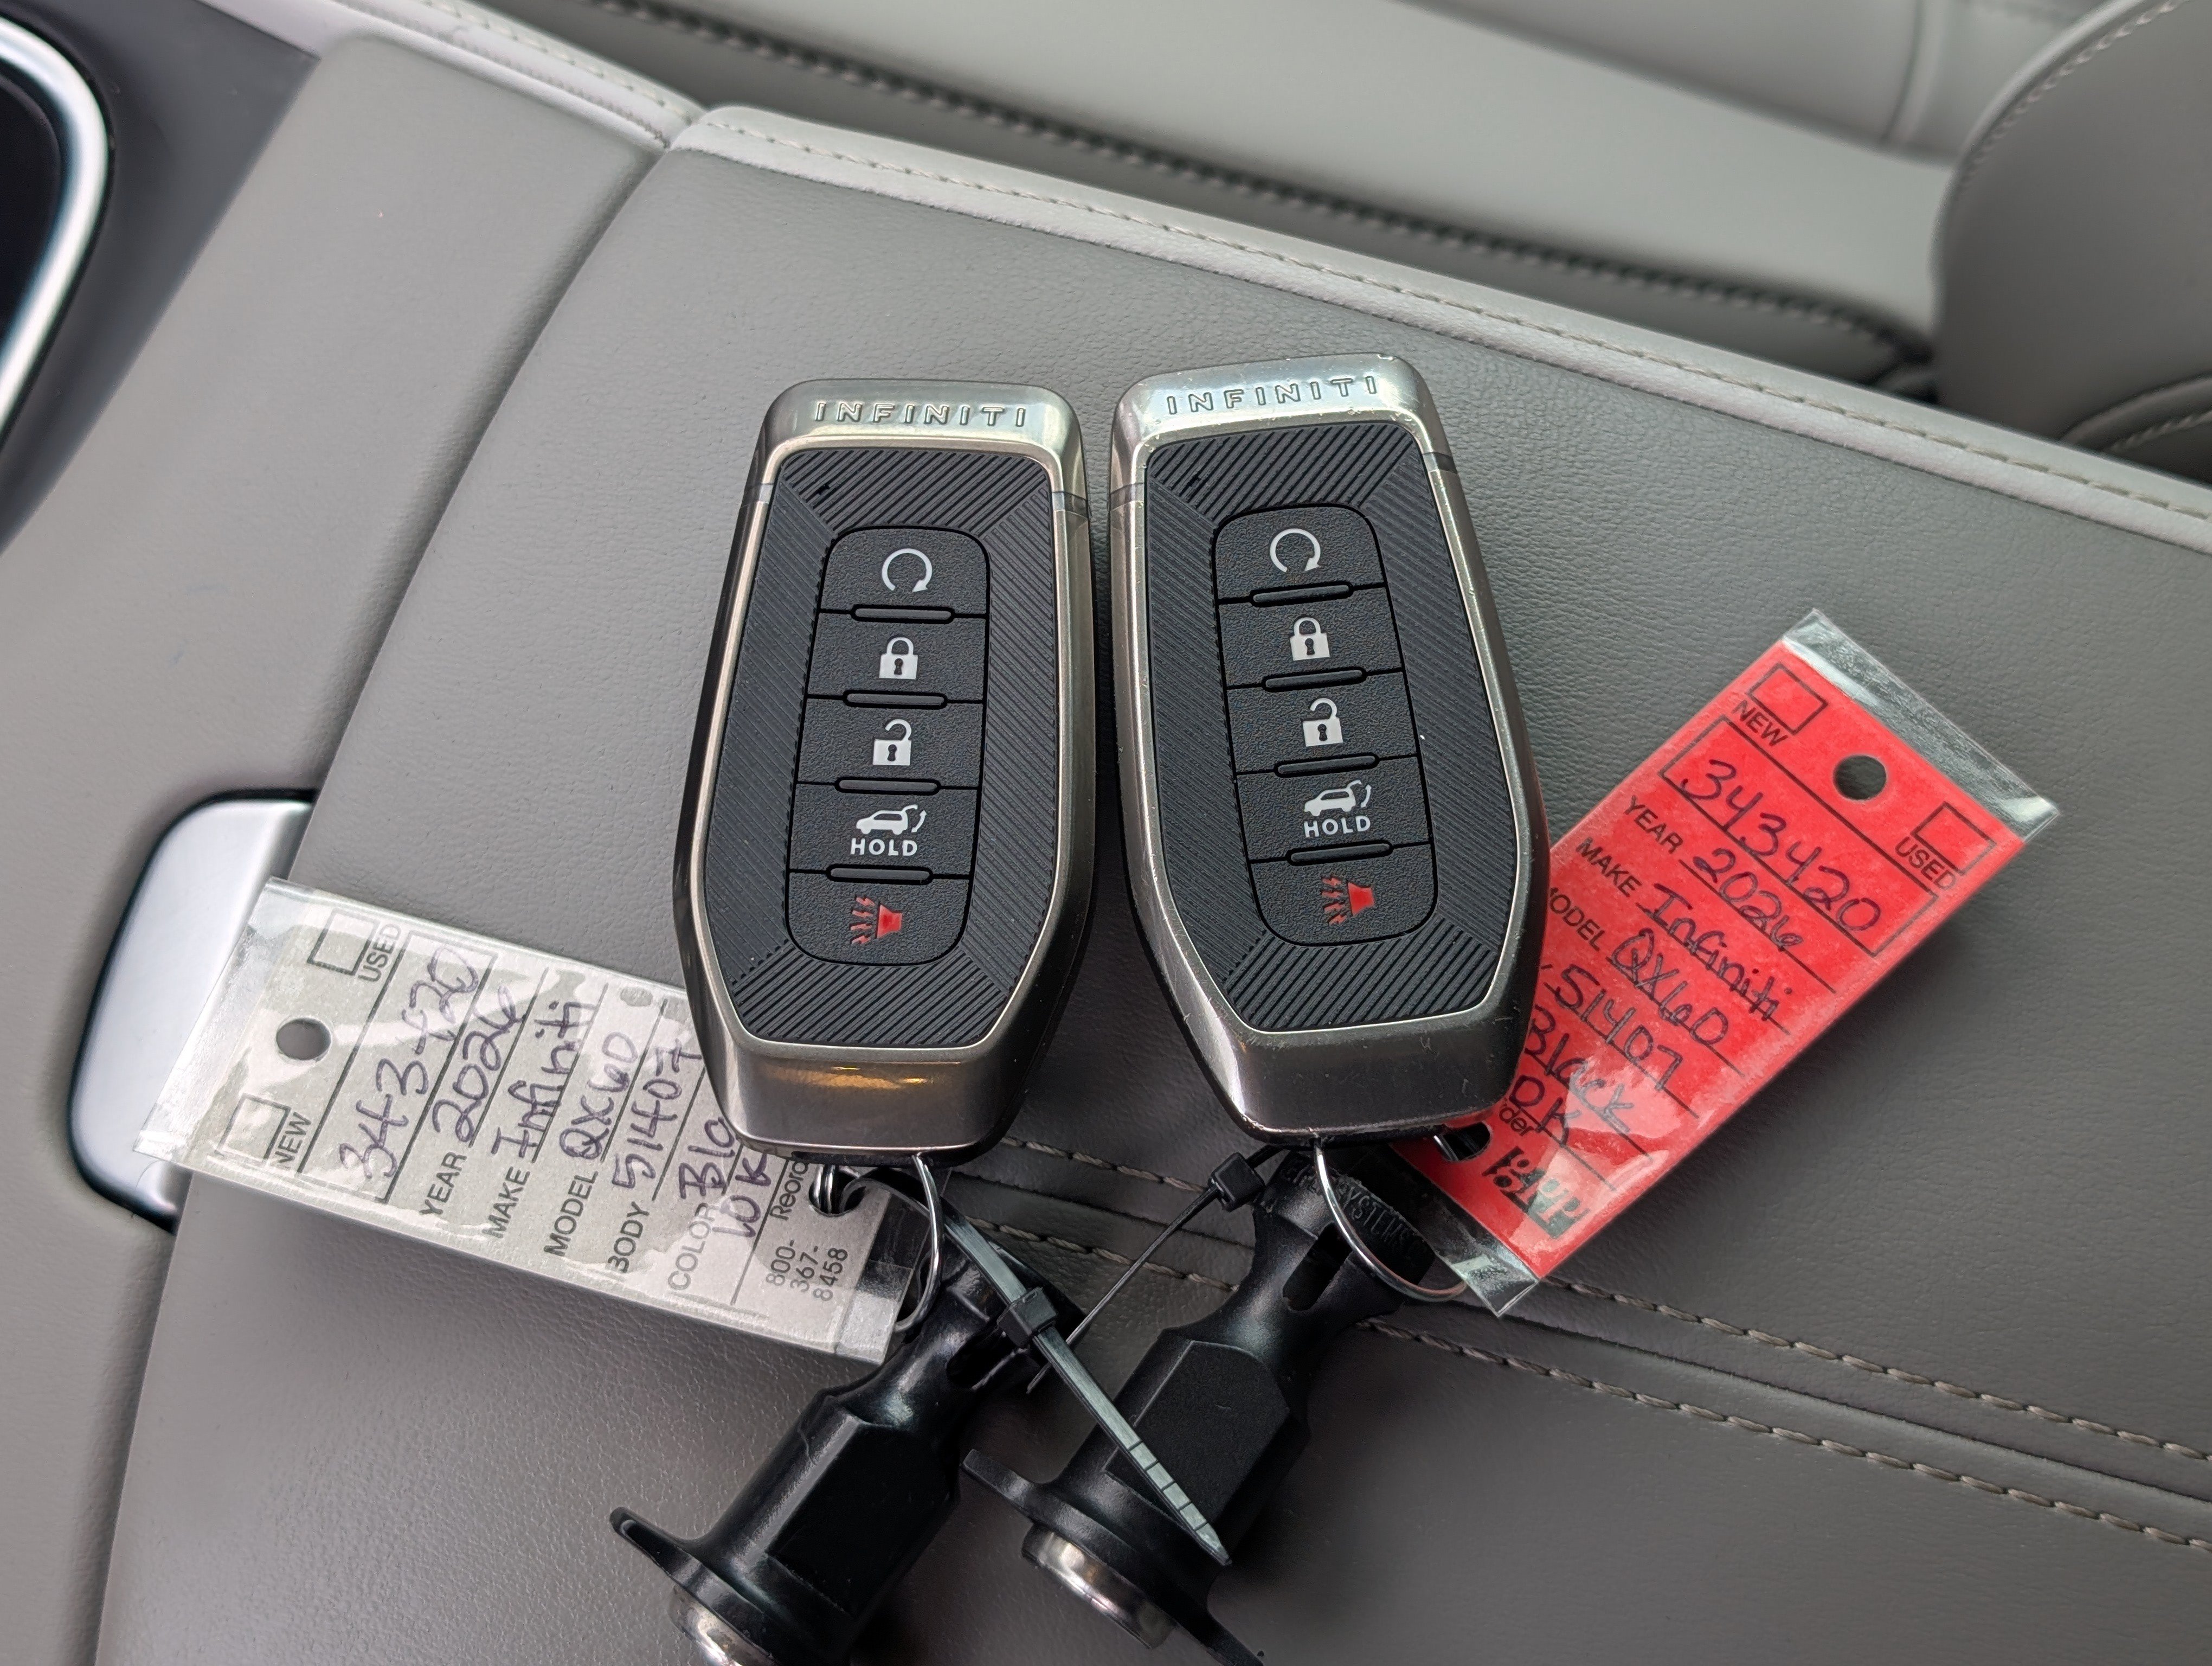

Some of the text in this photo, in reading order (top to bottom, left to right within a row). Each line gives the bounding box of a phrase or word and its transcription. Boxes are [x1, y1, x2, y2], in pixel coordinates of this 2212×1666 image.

[815, 401, 1026, 427] INFINITI
[1167, 375, 1377, 415] INFINITI
[1733, 700, 1787, 747] NEW
[850, 838, 917, 857] HOLD
[1303, 814, 1372, 838] HOLD
[1624, 796, 1683, 854] YEAR
[1681, 760, 1882, 933] 343420
[1576, 837, 1642, 898] MAKE
[1894, 837, 1956, 890] USED
[1693, 848, 1802, 951] 2026
[358, 924, 401, 983] USED
[1609, 928, 1730, 1046] QX60
[1637, 882, 1793, 1021] Infiniti
[1555, 963, 1682, 1087] 51407
[433, 986, 526, 1143] 2026
[490, 1001, 596, 1158] Infiniti
[559, 1031, 639, 1160] QX60
[1525, 1003, 1634, 1123] Black
[275, 1112, 312, 1164] NEW
[613, 1038, 702, 1189] 51407
[420, 1150, 467, 1216] YEAR
[679, 1117, 737, 1199] Bla
[483, 1167, 531, 1239] MAKE
[543, 1171, 598, 1257] MODEL
[607, 1201, 651, 1272] BODY
[668, 1202, 718, 1290] COLOR
[768, 1239, 796, 1285] 800-
[790, 1246, 819, 1292] 367-
[814, 1247, 848, 1301] 8458
